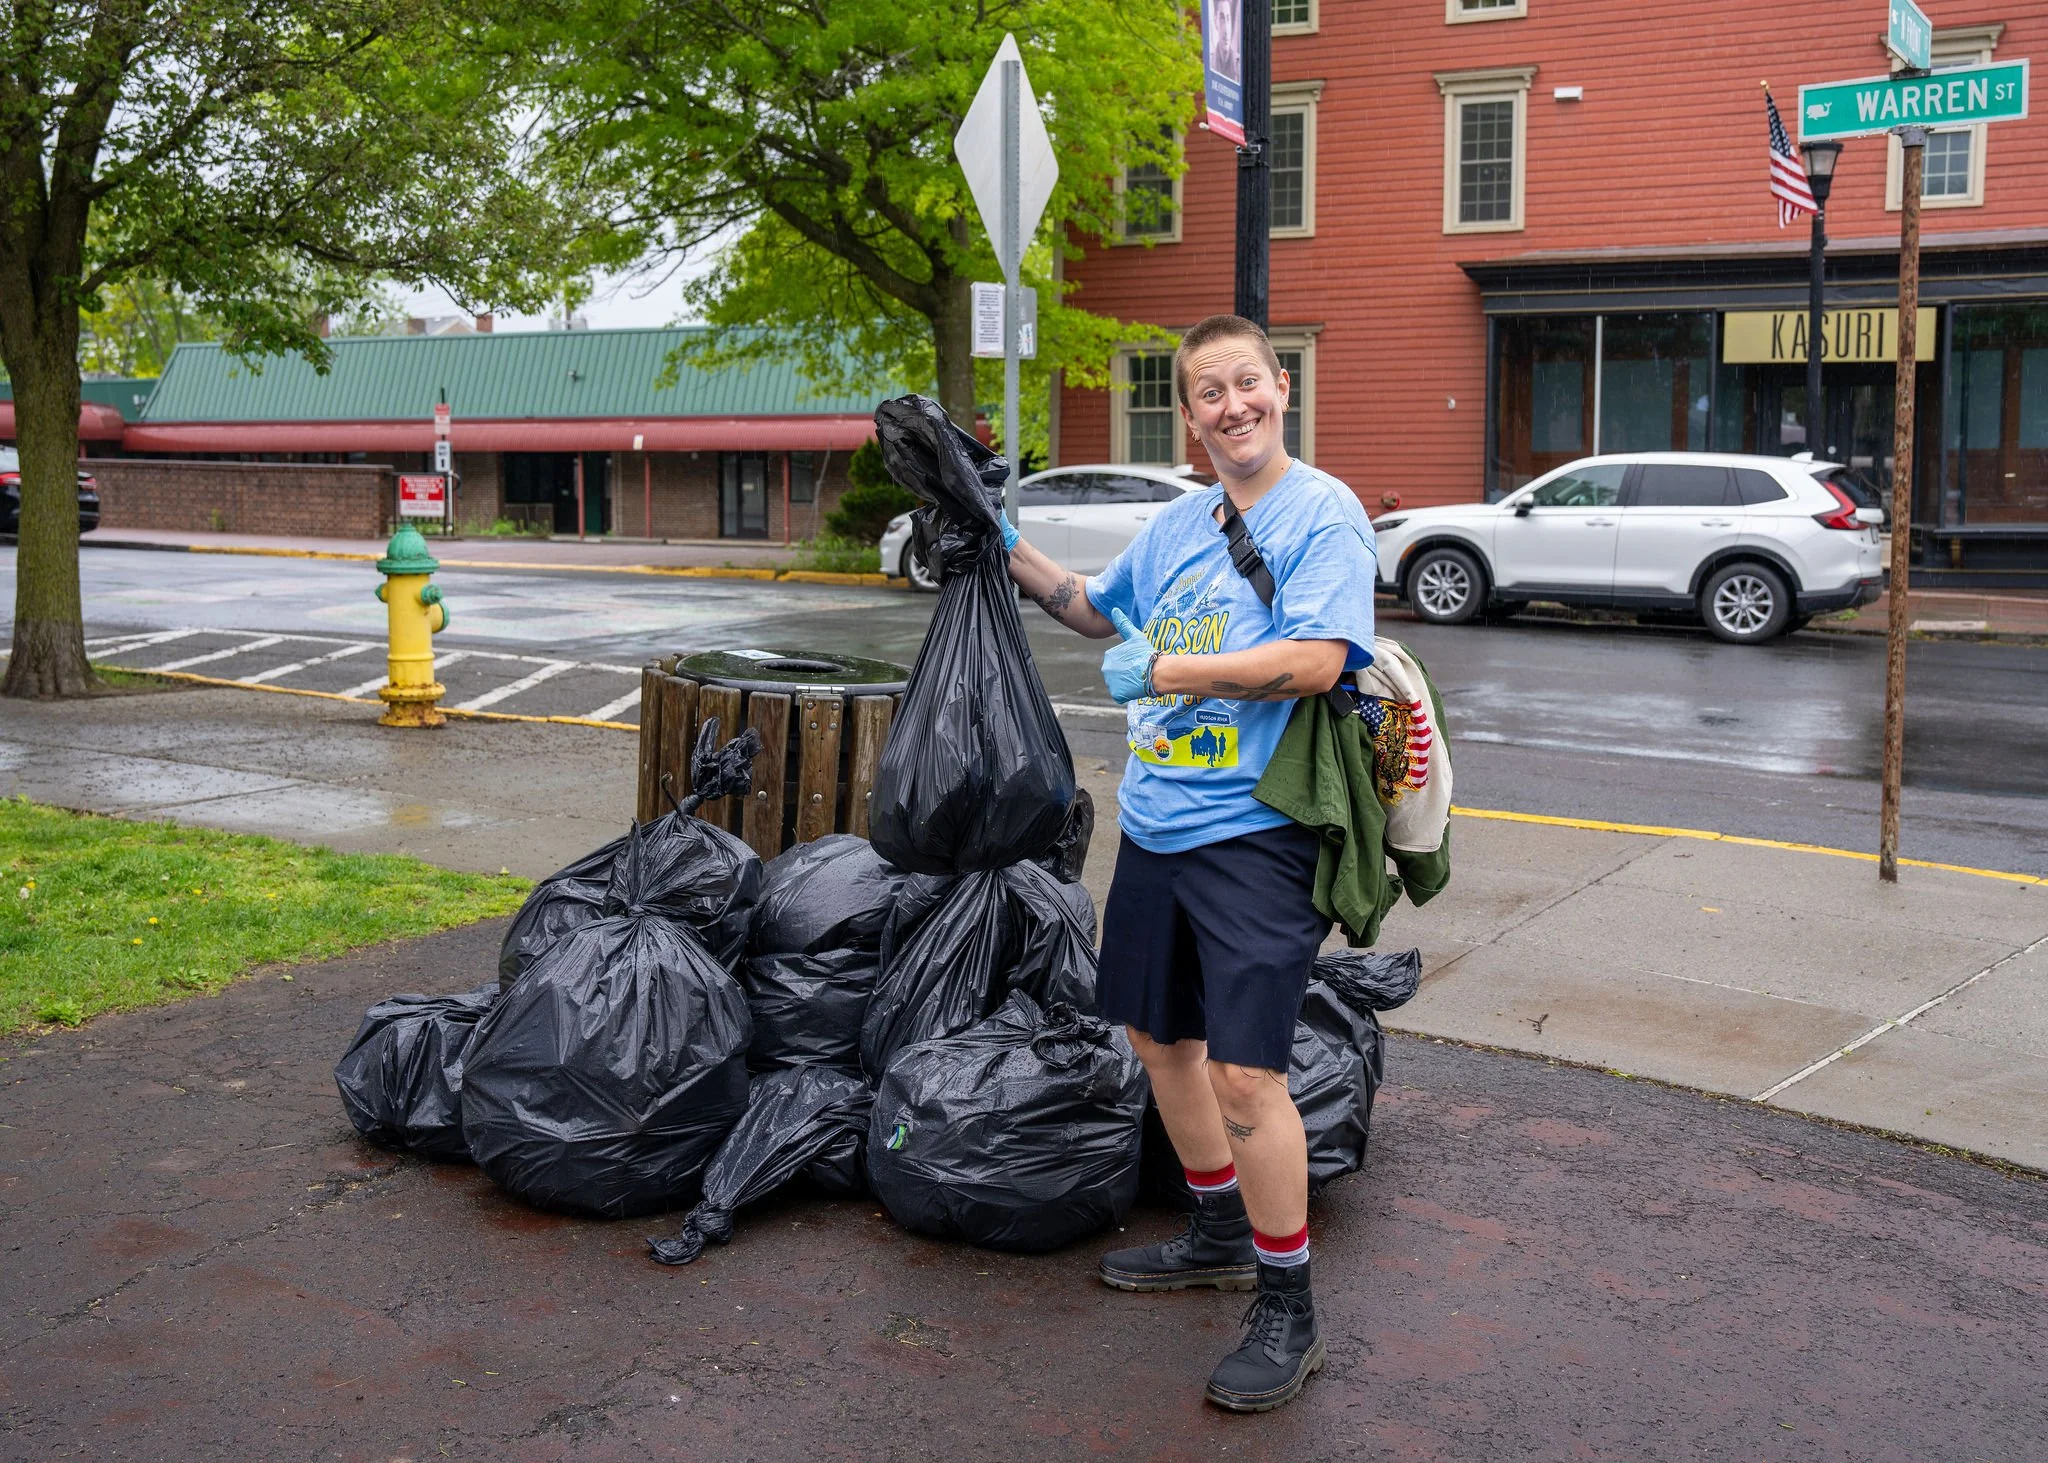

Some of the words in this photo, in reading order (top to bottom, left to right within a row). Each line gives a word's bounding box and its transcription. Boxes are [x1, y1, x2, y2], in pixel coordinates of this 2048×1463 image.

[1856, 78, 1988, 122] WARREN
[1994, 83, 2015, 101] ST
[1771, 312, 1885, 359] KASURI
